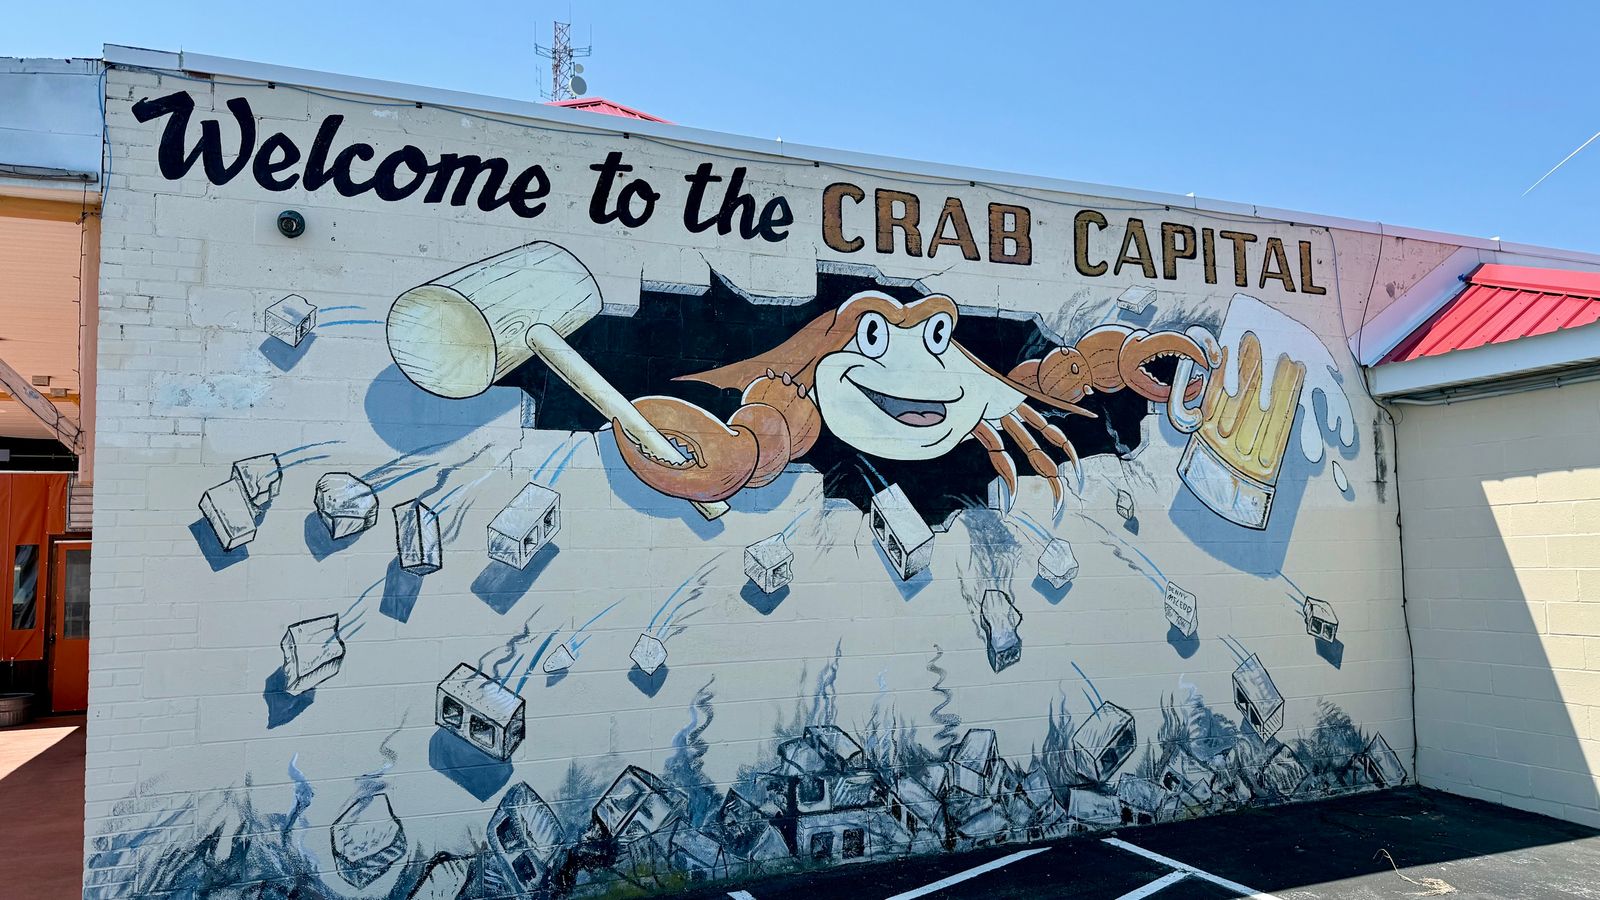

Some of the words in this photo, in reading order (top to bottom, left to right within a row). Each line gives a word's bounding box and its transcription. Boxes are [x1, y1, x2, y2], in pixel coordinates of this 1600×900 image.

[131, 90, 551, 218] Welcome
[589, 151, 661, 228] to
[683, 162, 794, 243] the
[821, 181, 1033, 266] CRAB
[1073, 209, 1327, 296] CAPITAL
[1168, 585, 1188, 600] DENNY
